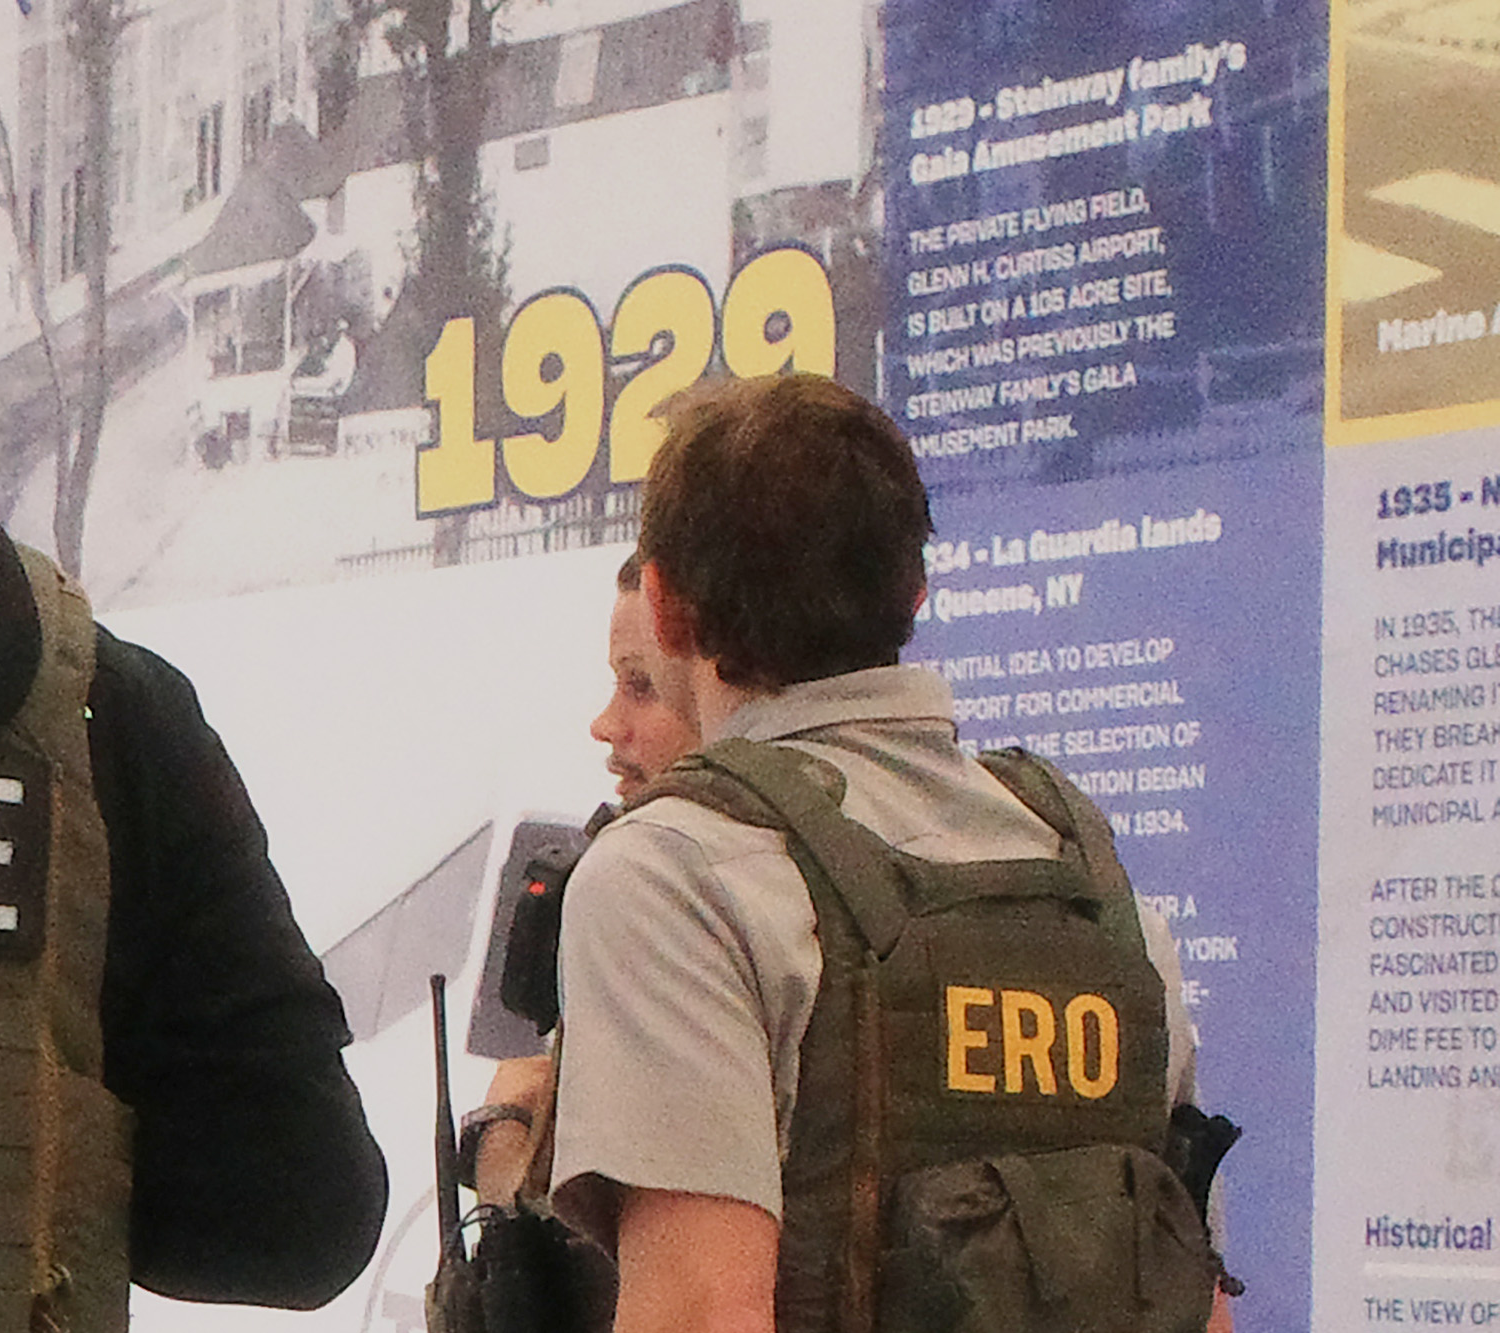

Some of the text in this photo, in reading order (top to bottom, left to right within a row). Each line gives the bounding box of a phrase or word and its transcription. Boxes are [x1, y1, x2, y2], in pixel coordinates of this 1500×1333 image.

[997, 68, 1125, 120] Steinway
[1128, 40, 1246, 91] family's
[911, 92, 1213, 185] Gala Amusement Park
[909, 226, 945, 254] THE
[947, 212, 1020, 244] PRIVATE
[1022, 199, 1088, 234] FLYING
[908, 263, 970, 296] GLENN
[972, 260, 992, 285] H.
[994, 242, 1076, 280] CURTISS
[908, 313, 926, 338] IS
[928, 301, 978, 334] BUILT
[980, 298, 1009, 326] ON
[1011, 295, 1028, 320] A
[1068, 277, 1121, 309] ACRE
[907, 311, 1177, 379] WHICH WAS PREVIOUSLY THE
[1378, 306, 1485, 352] Marine
[417, 240, 837, 519] 1929
[906, 361, 1138, 420] STEINWAY FAMILY'S GALA
[1377, 480, 1453, 520] 1935
[993, 535, 1026, 566] La
[1029, 519, 1139, 562] Guardia
[1141, 507, 1223, 549] lands
[1376, 527, 1500, 570] Municip
[935, 583, 1044, 623] Queens,
[1046, 572, 1084, 607] NY
[1375, 616, 1396, 641] IN
[944, 653, 1006, 681] INITIAL
[1008, 649, 1052, 676] IDEA
[1057, 645, 1083, 672] TO
[1084, 637, 1176, 668] DEVELOP
[1373, 648, 1460, 678] CHASES
[1015, 691, 1053, 718] FOR
[1056, 680, 1186, 713] COMMERCIAL
[1373, 683, 1486, 716] RENAMING
[1024, 731, 1062, 757] THE
[1063, 725, 1173, 756] SELECTION
[1173, 720, 1202, 748] OF
[1373, 727, 1428, 753] THEY
[1136, 763, 1208, 793] BEGAN
[1372, 759, 1498, 791] DEDICATE IT
[1110, 813, 1131, 836] IN
[1372, 799, 1485, 828] MUNICIPAL
[1182, 894, 1199, 918] A
[1371, 876, 1438, 902] AFTER
[1445, 874, 1485, 900] THE
[1369, 911, 1500, 940] CONSTRUCT
[1184, 936, 1239, 961] YORK
[1370, 949, 1498, 976] FASCINATED
[1368, 989, 1499, 1015] AND VISITED
[945, 984, 1120, 1100] ERO
[1368, 1025, 1498, 1052] DIME FEE TO
[1367, 1064, 1462, 1089] LANDING
[1365, 1214, 1493, 1251] Historical
[1363, 1297, 1500, 1326] THE VIEW OF
